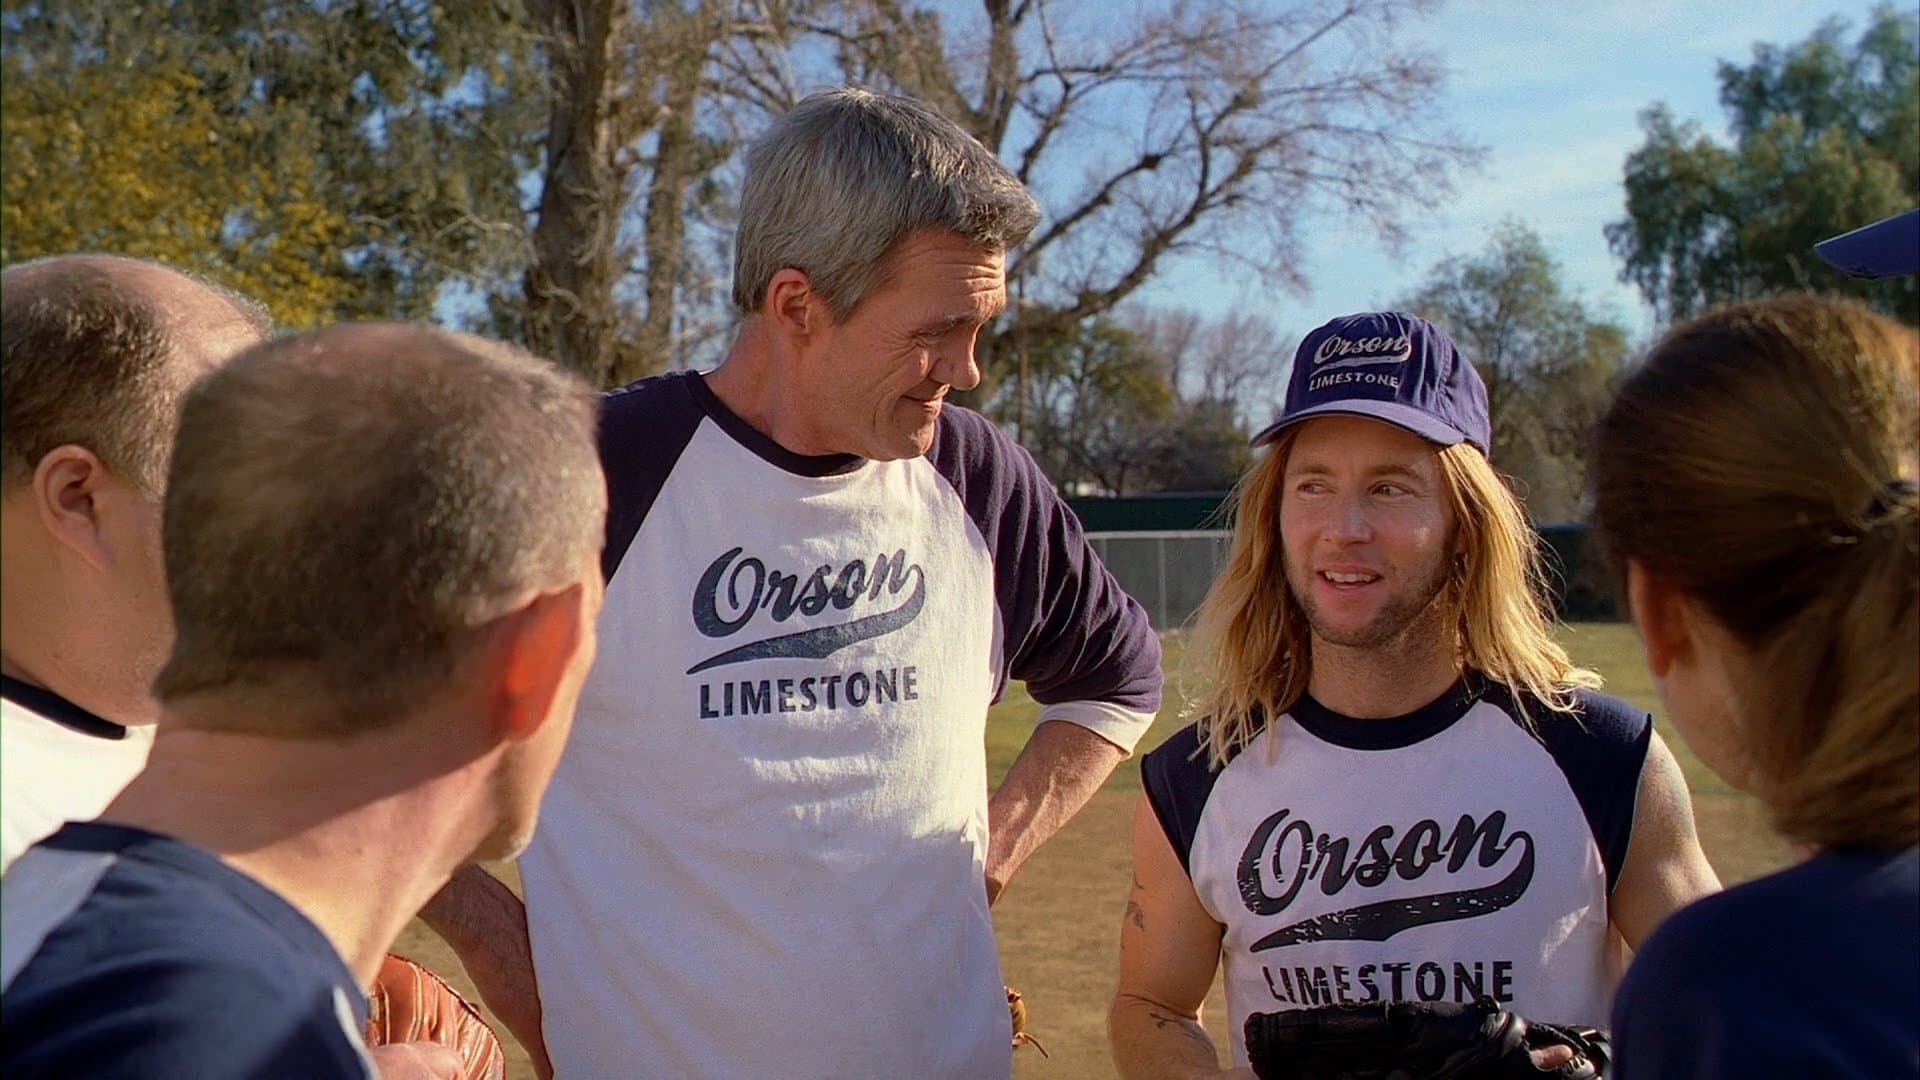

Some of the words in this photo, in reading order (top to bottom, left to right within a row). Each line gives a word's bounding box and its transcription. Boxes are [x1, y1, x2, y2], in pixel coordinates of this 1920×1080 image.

[1313, 333, 1411, 365] Orson
[1308, 372, 1399, 392] LIMESTONE
[692, 547, 925, 638] Orson
[700, 666, 919, 719] LIMESTONE
[1237, 808, 1534, 916] Orson
[1262, 961, 1513, 1005] LIMESTONE
